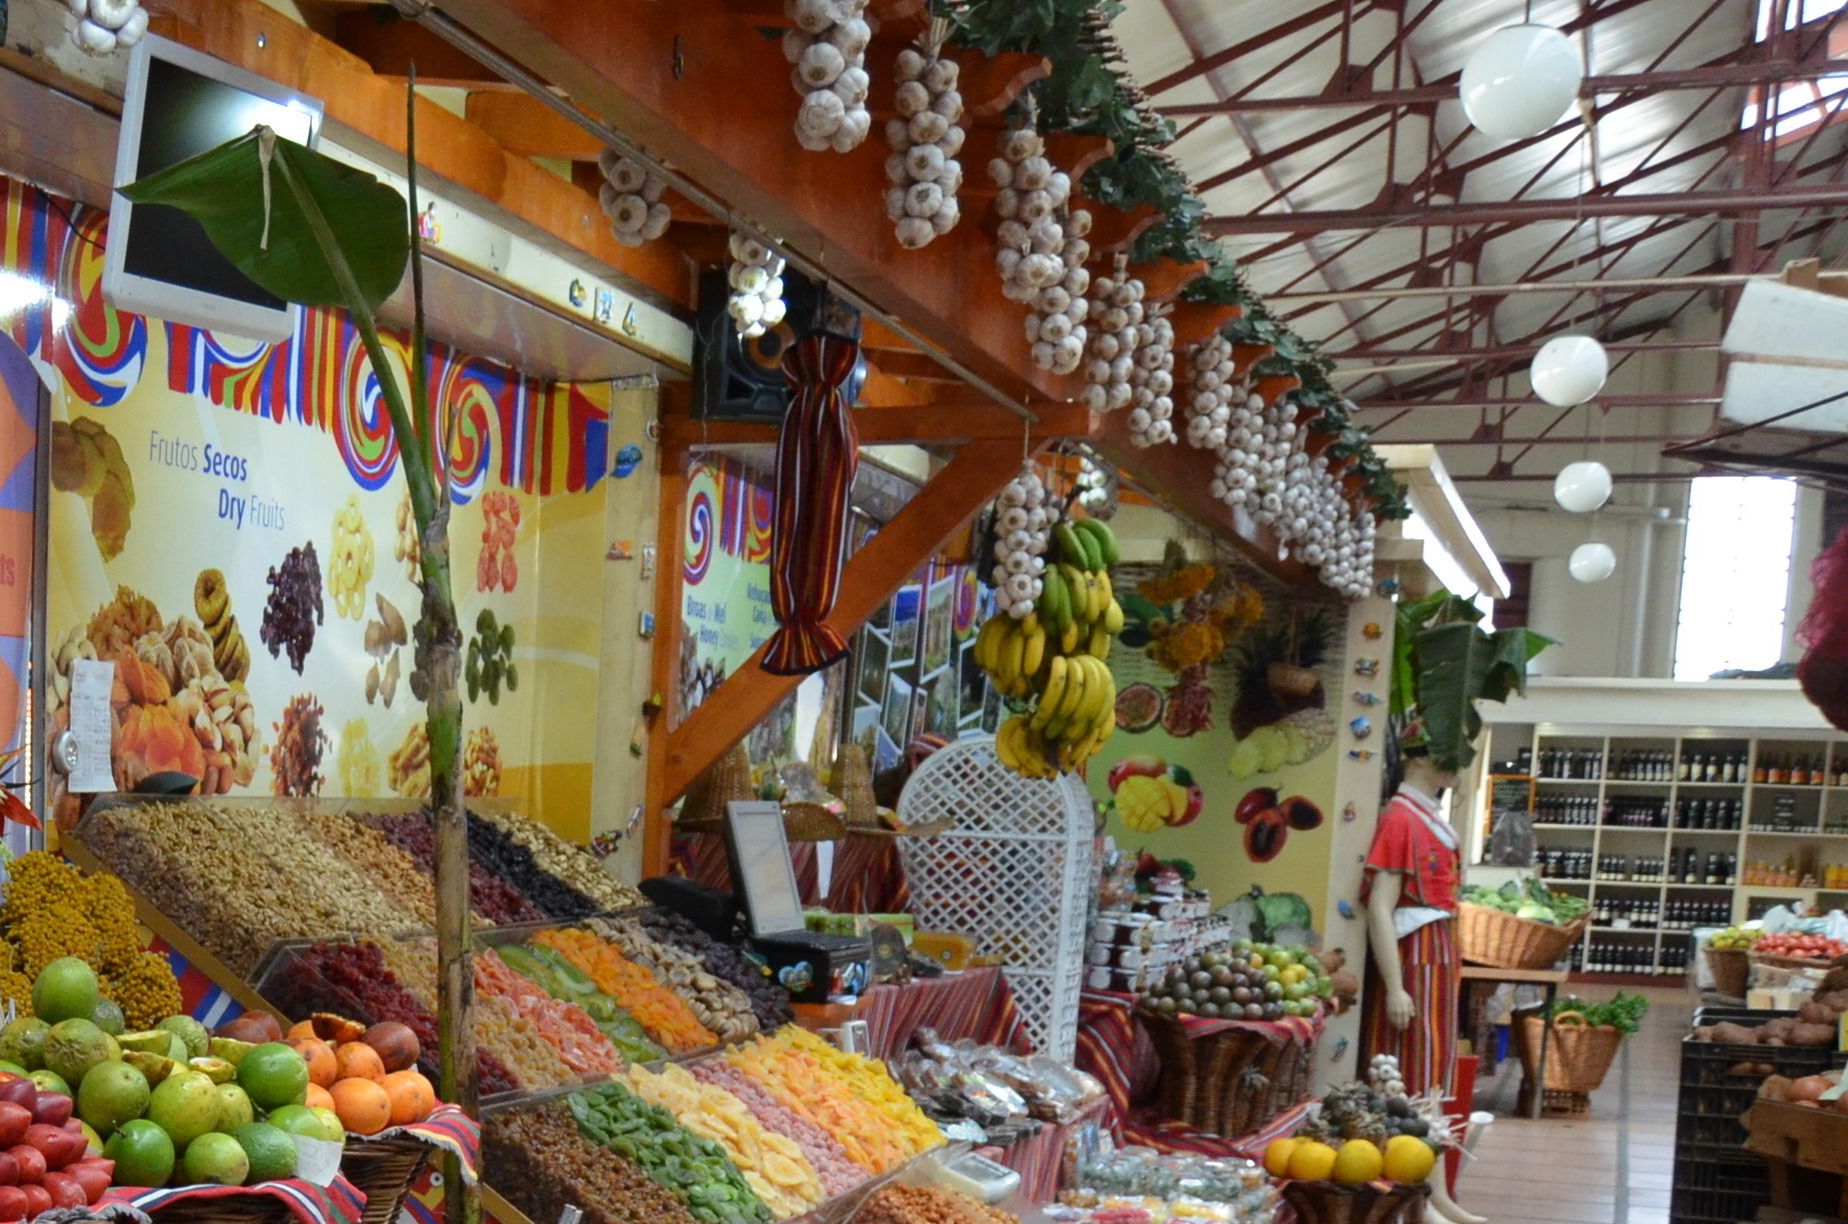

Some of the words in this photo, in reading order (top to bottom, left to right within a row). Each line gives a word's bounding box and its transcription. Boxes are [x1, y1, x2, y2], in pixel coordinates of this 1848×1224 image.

[149, 430, 199, 471] Frutos
[203, 443, 248, 482] Secos
[218, 488, 246, 531] Dry
[249, 495, 286, 531] Fruits
